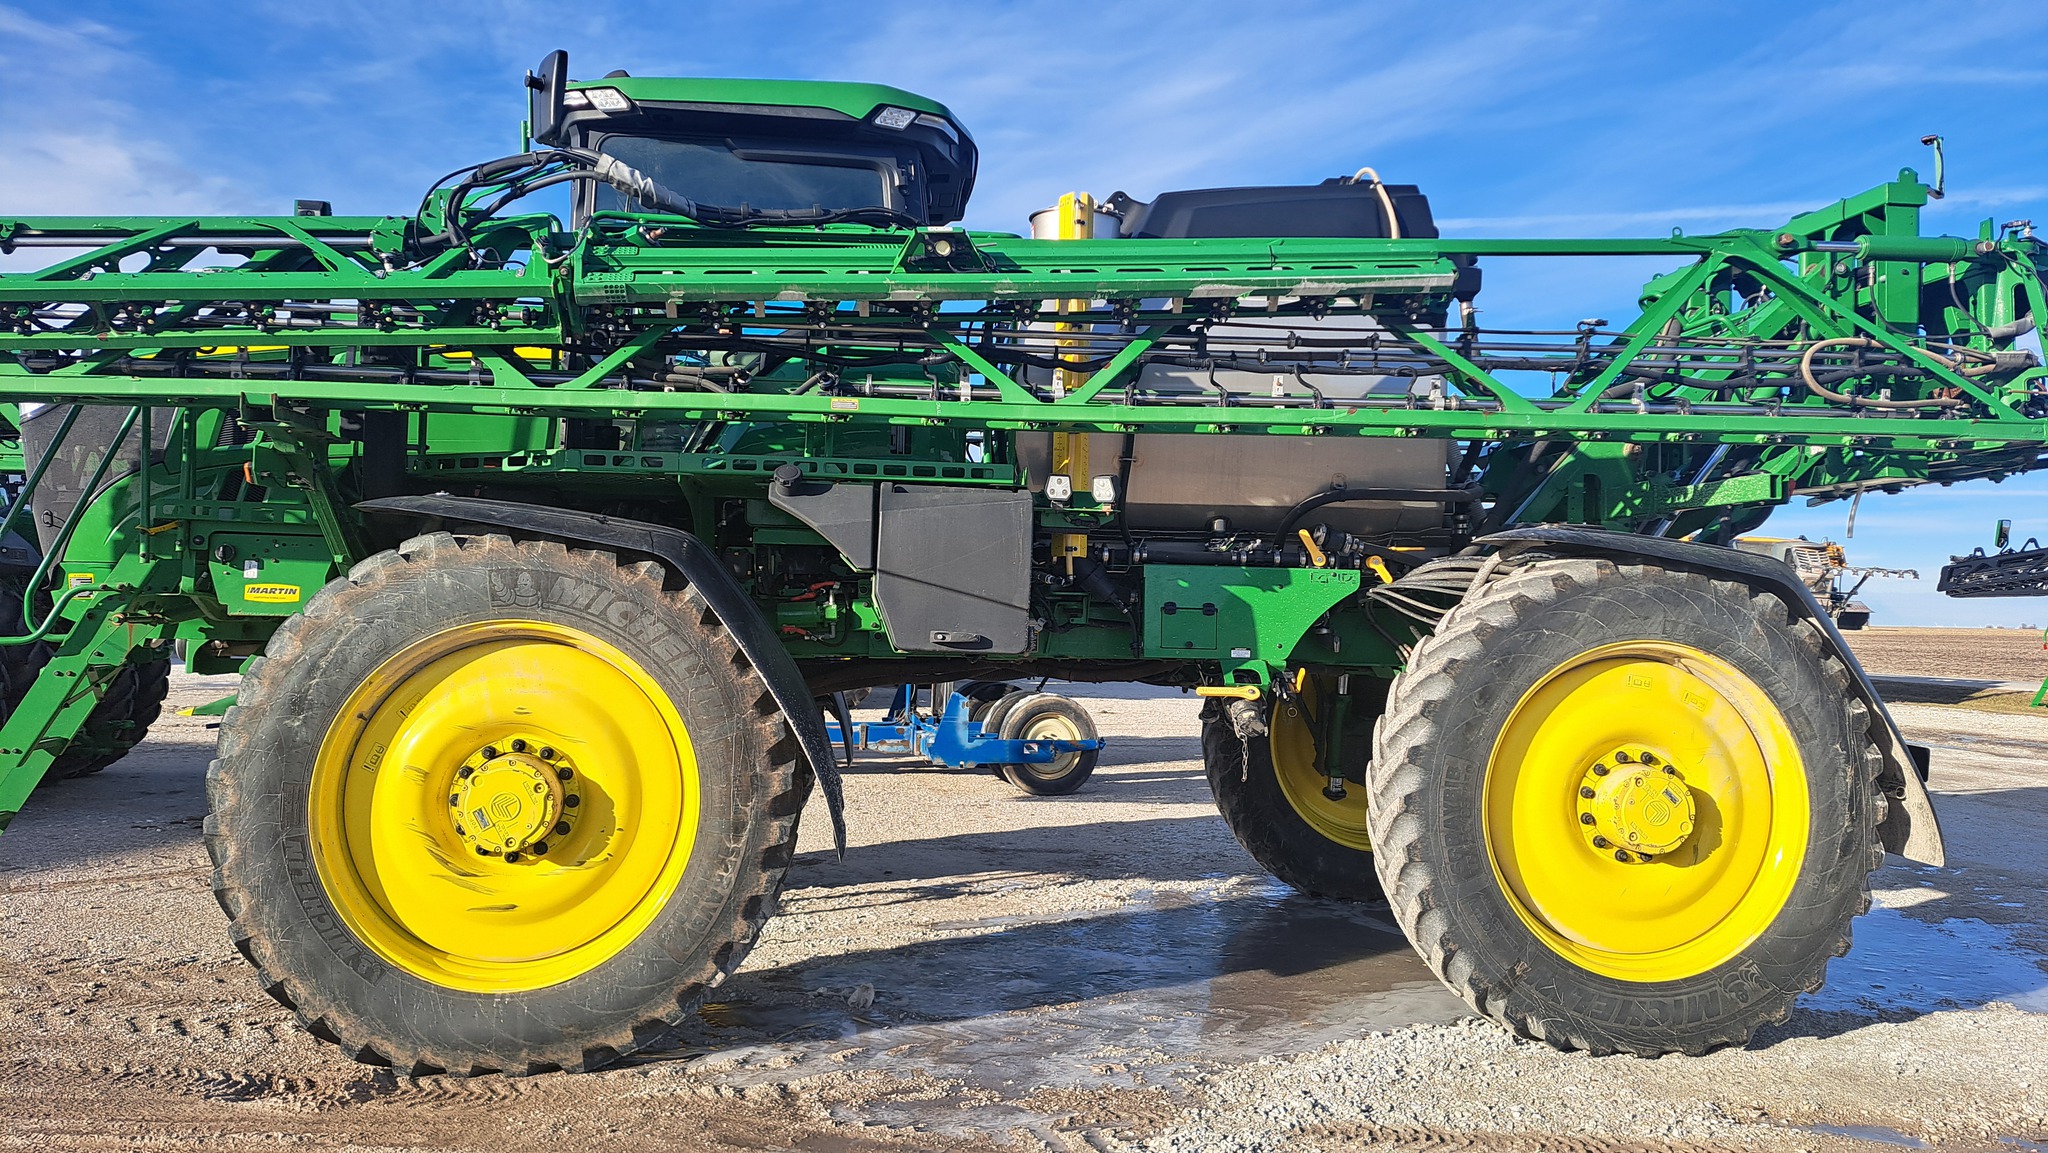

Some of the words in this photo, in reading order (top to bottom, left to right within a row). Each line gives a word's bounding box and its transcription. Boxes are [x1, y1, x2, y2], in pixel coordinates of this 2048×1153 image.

[248, 587, 297, 595] MARTIN
[549, 575, 730, 726] MICHELIN
[284, 838, 358, 965] MICHELIN
